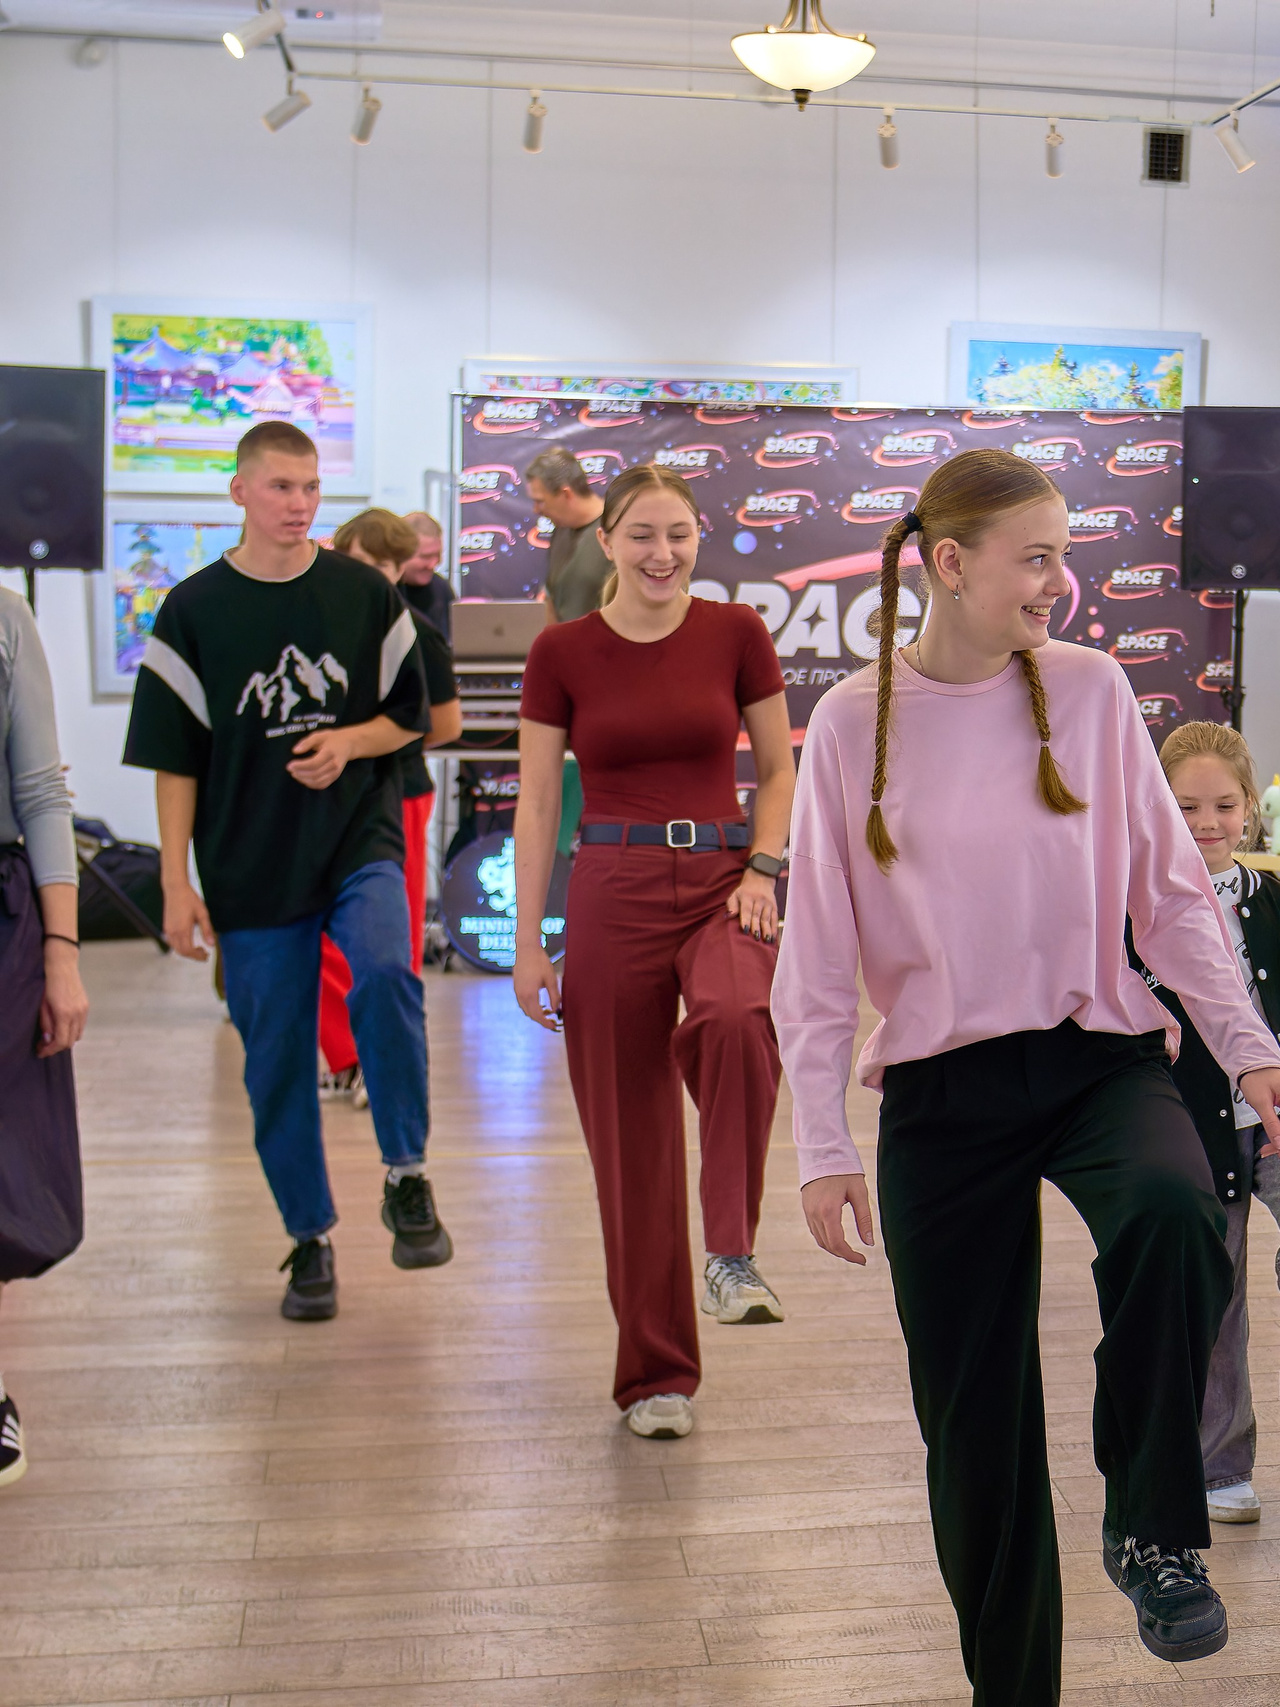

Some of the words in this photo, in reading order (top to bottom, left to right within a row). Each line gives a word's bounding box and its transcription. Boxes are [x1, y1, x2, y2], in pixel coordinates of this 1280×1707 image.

[483, 400, 540, 419] SPACE
[588, 400, 642, 413] SPACE
[764, 436, 819, 454] SPACE
[882, 435, 937, 452] SPACE
[1012, 442, 1067, 460] SPACE
[655, 449, 710, 467] SPACE
[1115, 445, 1169, 462] SPACE
[459, 471, 500, 489] PACE
[746, 496, 801, 513] SPACE
[850, 491, 905, 509] SPACE
[1068, 511, 1119, 528] SPACE
[1110, 568, 1164, 586] SPACE
[1116, 634, 1169, 651] SPACE
[783, 668, 807, 685] ОЕ
[809, 669, 851, 685] ПРО
[1205, 662, 1234, 678] SPA
